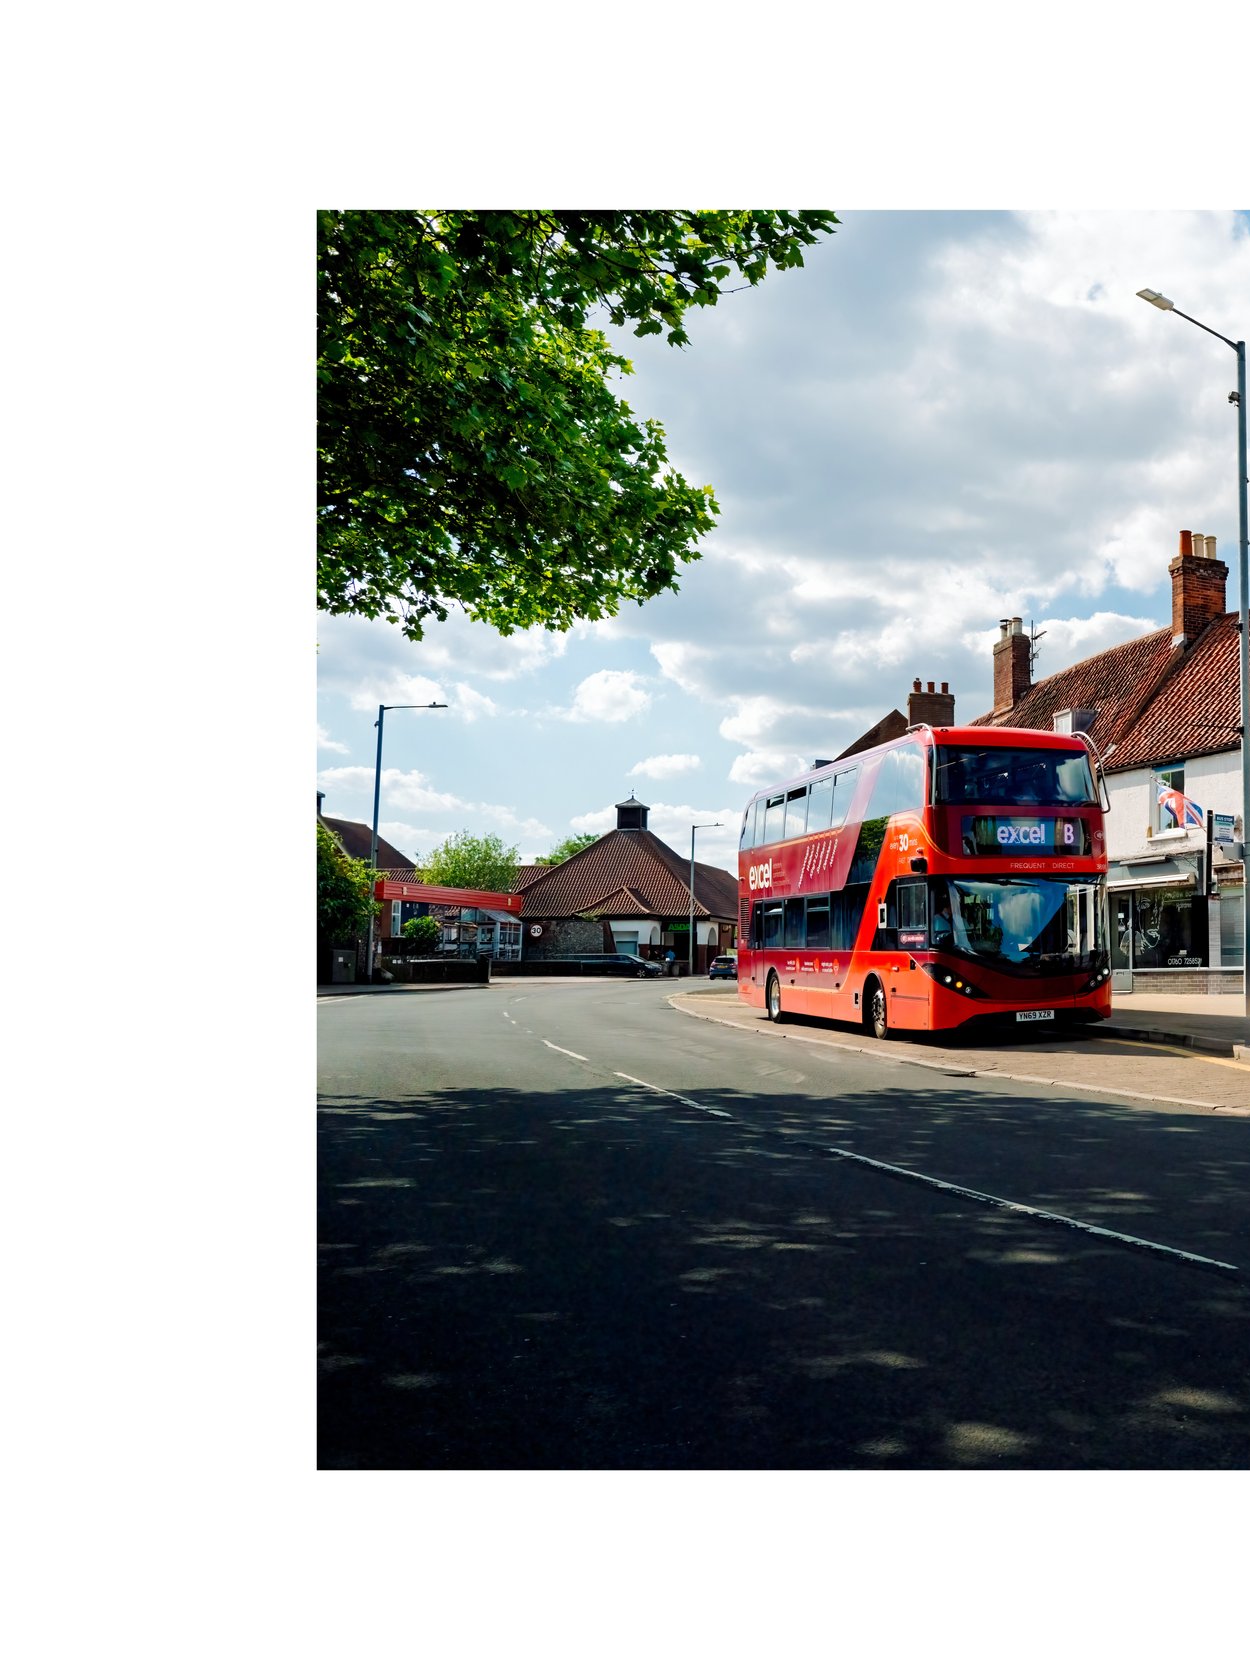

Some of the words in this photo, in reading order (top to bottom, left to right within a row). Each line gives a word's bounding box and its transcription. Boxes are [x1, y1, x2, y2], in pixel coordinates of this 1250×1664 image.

[899, 834, 909, 852] 30
[997, 824, 1045, 844] excel
[1064, 823, 1075, 844] B
[749, 858, 773, 891] excel
[1018, 1011, 1037, 1020] YN69
[1038, 1010, 1052, 1019] XZR
